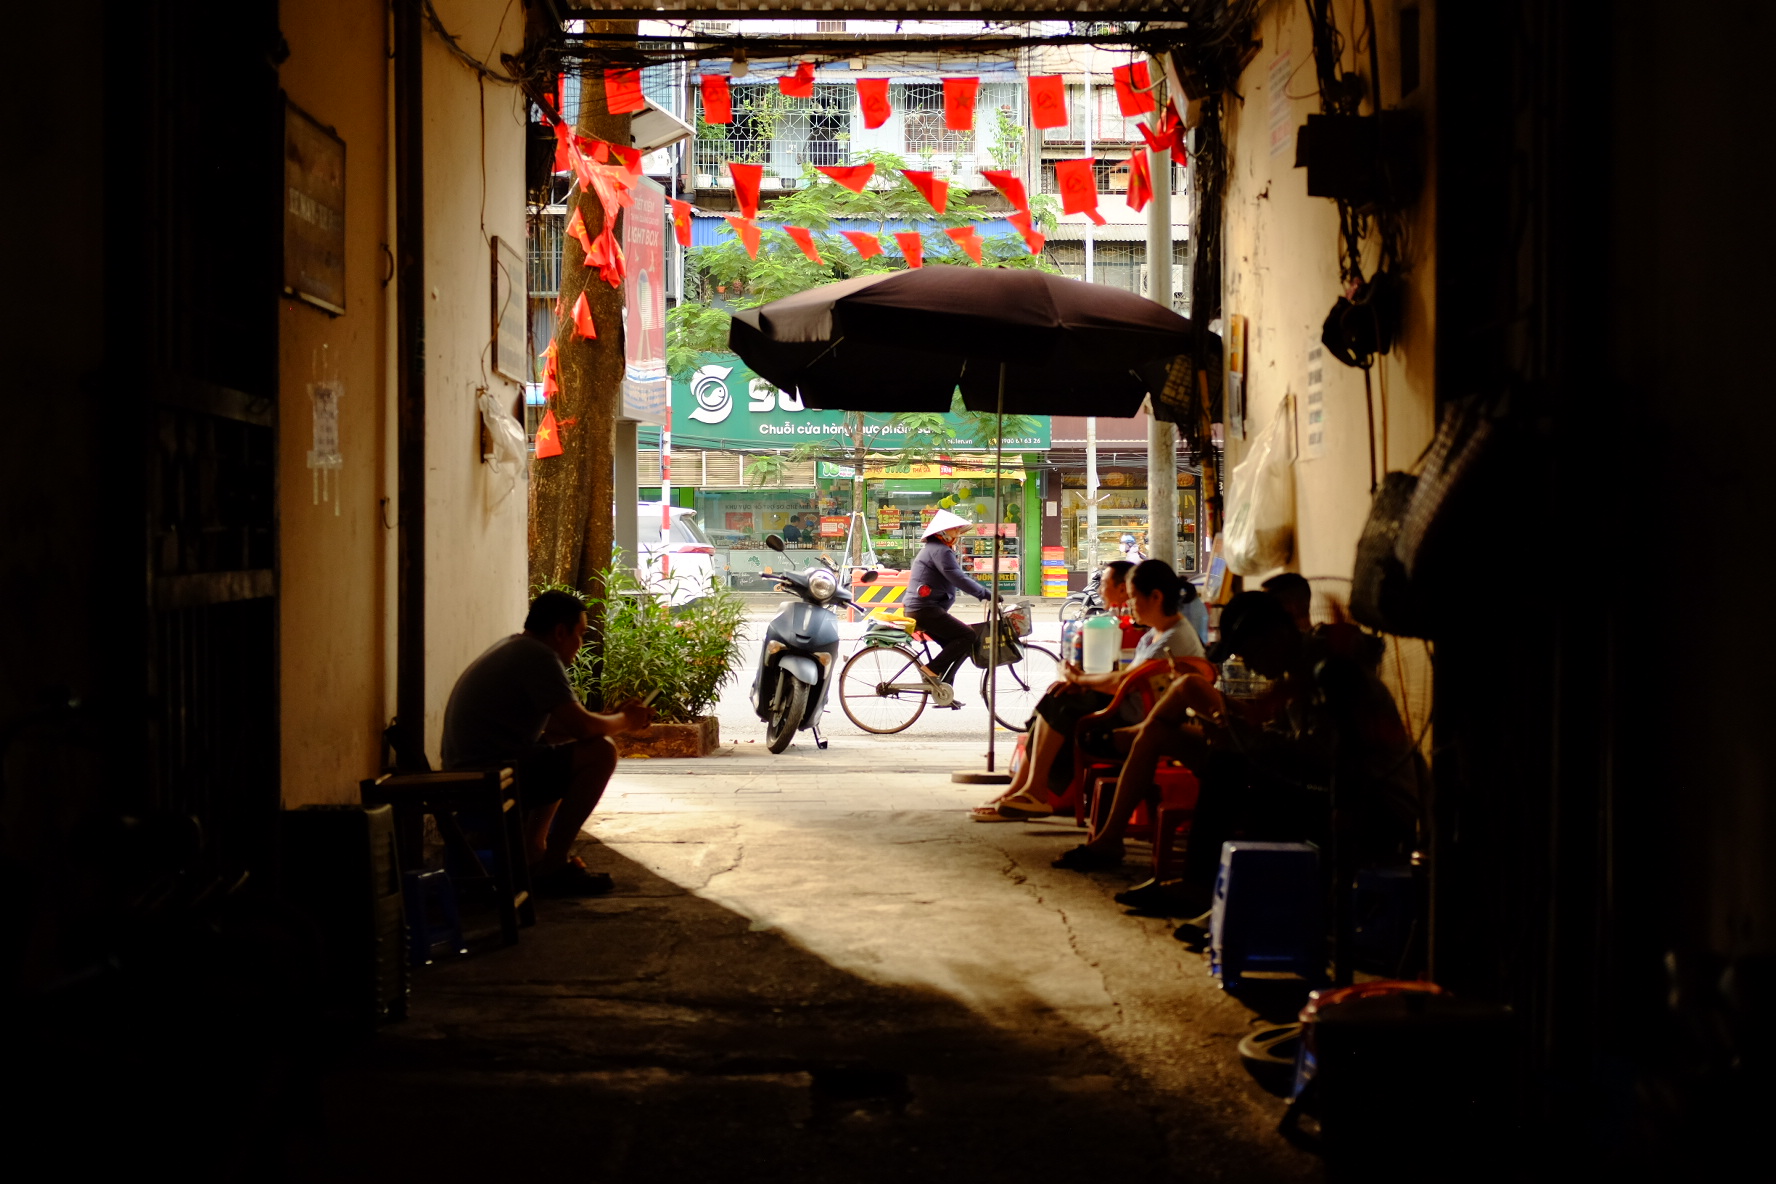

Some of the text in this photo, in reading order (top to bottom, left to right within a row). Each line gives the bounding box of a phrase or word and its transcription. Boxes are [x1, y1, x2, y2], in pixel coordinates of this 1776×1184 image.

[627, 226, 659, 247] LIGHT BOX
[759, 421, 795, 434] Chuỗi
[797, 421, 820, 434] cửa
[822, 422, 852, 437] hàng
